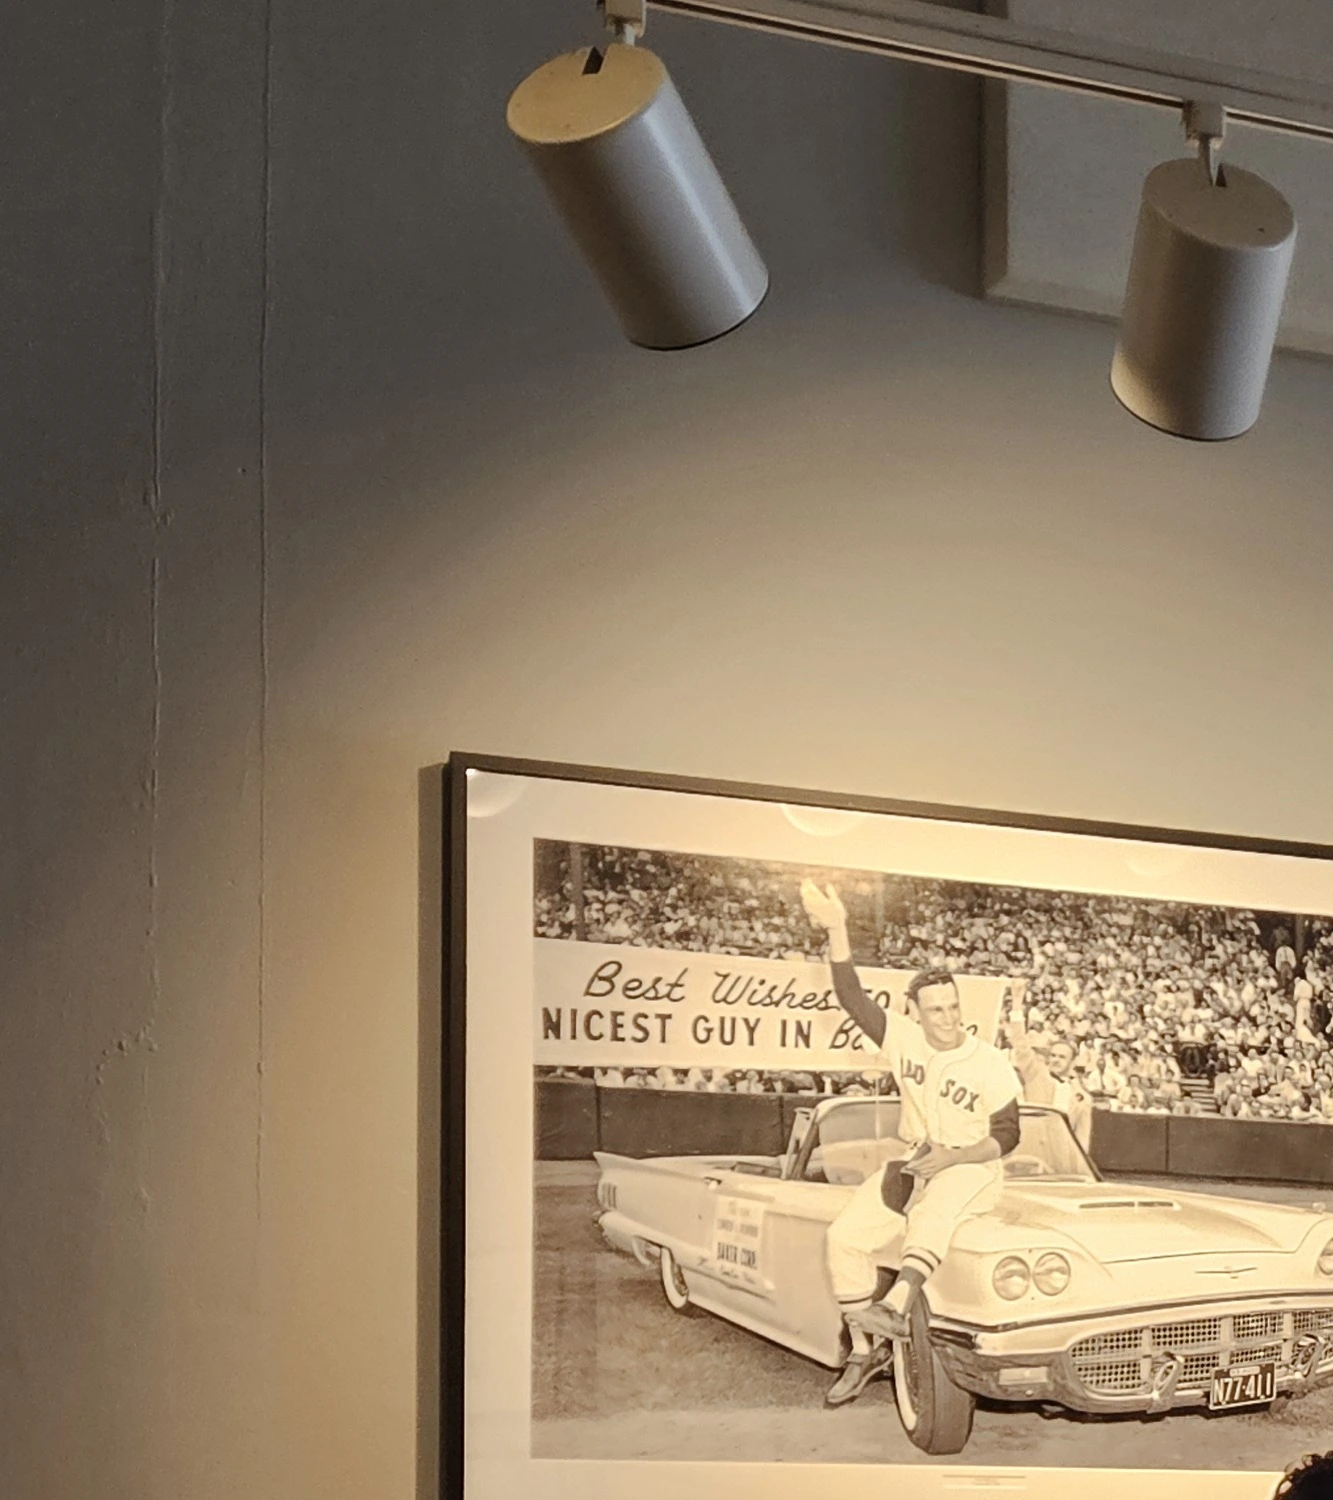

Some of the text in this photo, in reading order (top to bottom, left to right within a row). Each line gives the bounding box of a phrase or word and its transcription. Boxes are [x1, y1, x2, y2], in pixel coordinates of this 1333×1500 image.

[583, 960, 688, 1002] Best
[711, 970, 841, 1011] Wishes
[542, 1007, 673, 1044] NICEST
[692, 1015, 761, 1048] GUY
[780, 1019, 812, 1049] IN
[940, 1079, 979, 1113] SOX
